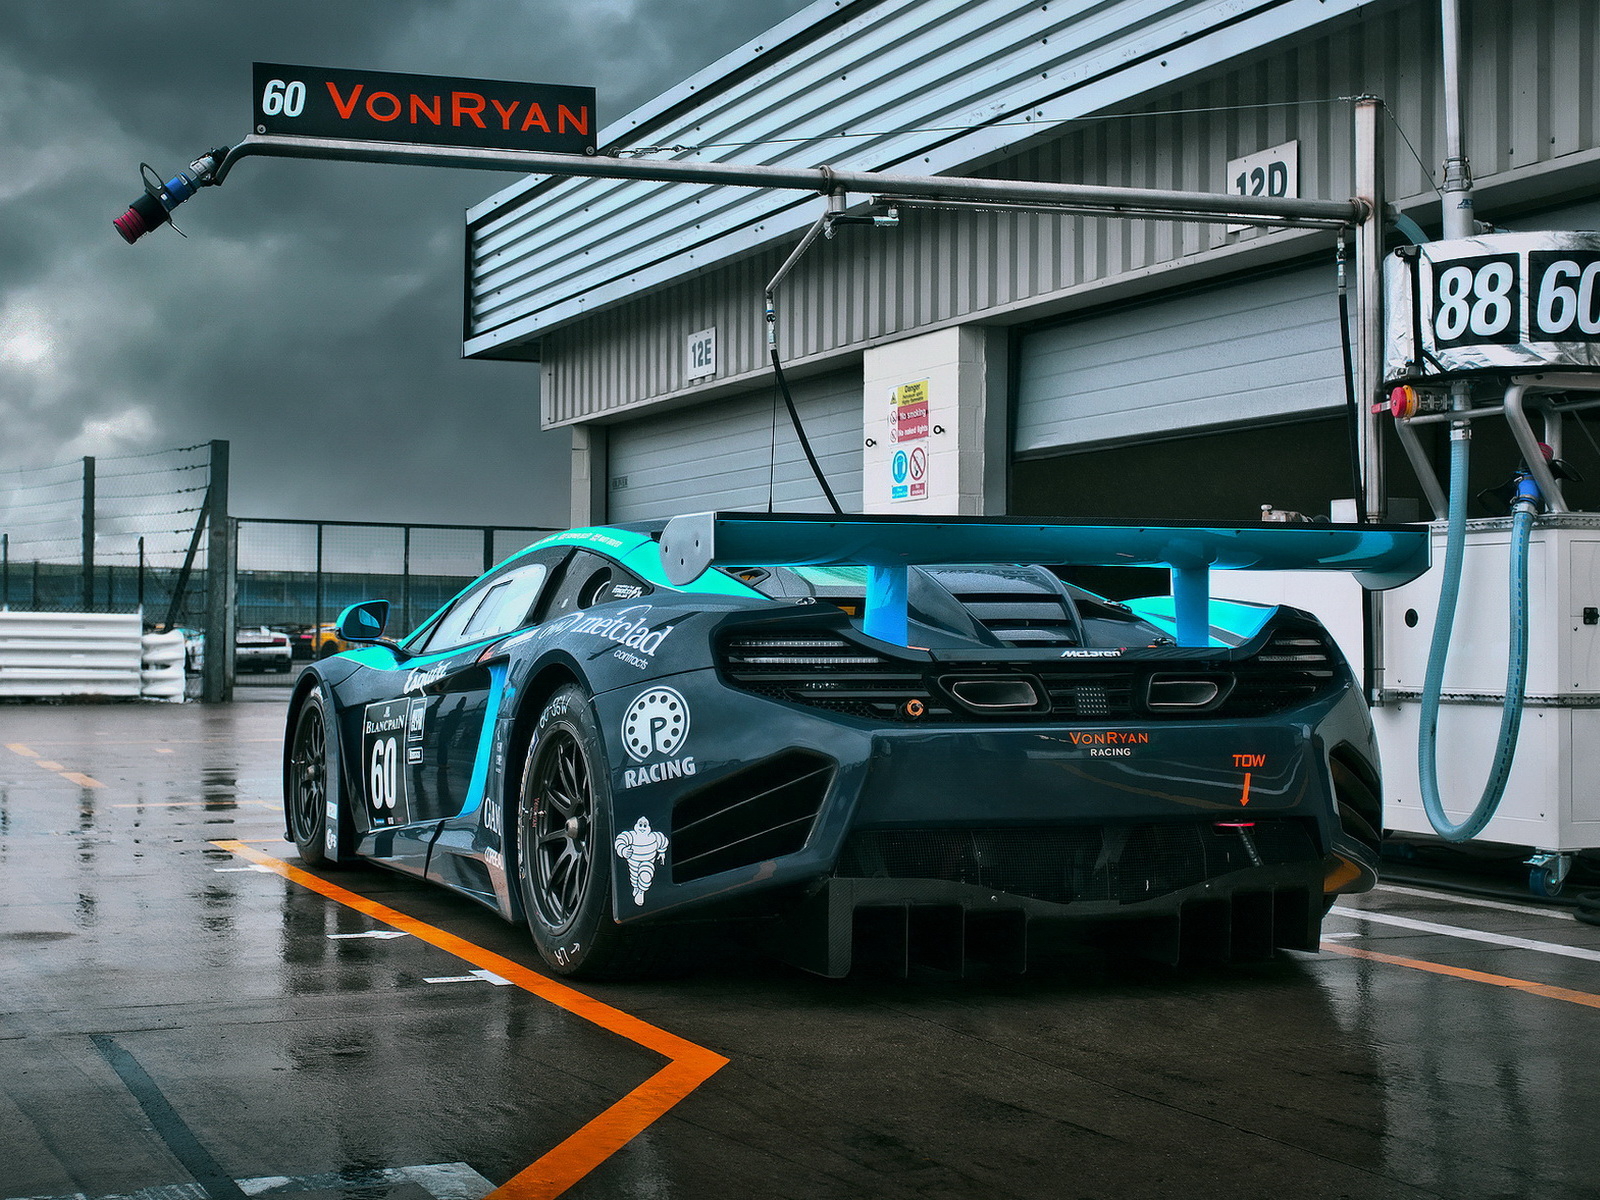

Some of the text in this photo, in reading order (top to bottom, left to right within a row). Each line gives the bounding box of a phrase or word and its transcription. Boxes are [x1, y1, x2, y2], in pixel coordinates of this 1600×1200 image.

[262, 79, 307, 118] 60
[1236, 160, 1288, 198] 12D
[1435, 261, 1514, 341] 88
[1536, 260, 1600, 335] 60
[691, 338, 712, 369] 12E
[904, 383, 921, 393] Danger
[907, 408, 926, 419] smoking
[571, 616, 675, 657] metclad
[613, 649, 649, 670] contracts
[1060, 650, 1121, 658] McLaren
[365, 714, 406, 734] BLANCPAIN
[1090, 747, 1131, 757] RACING
[1232, 754, 1266, 767] TOW
[370, 737, 397, 810] 60
[624, 756, 697, 789] RACING
